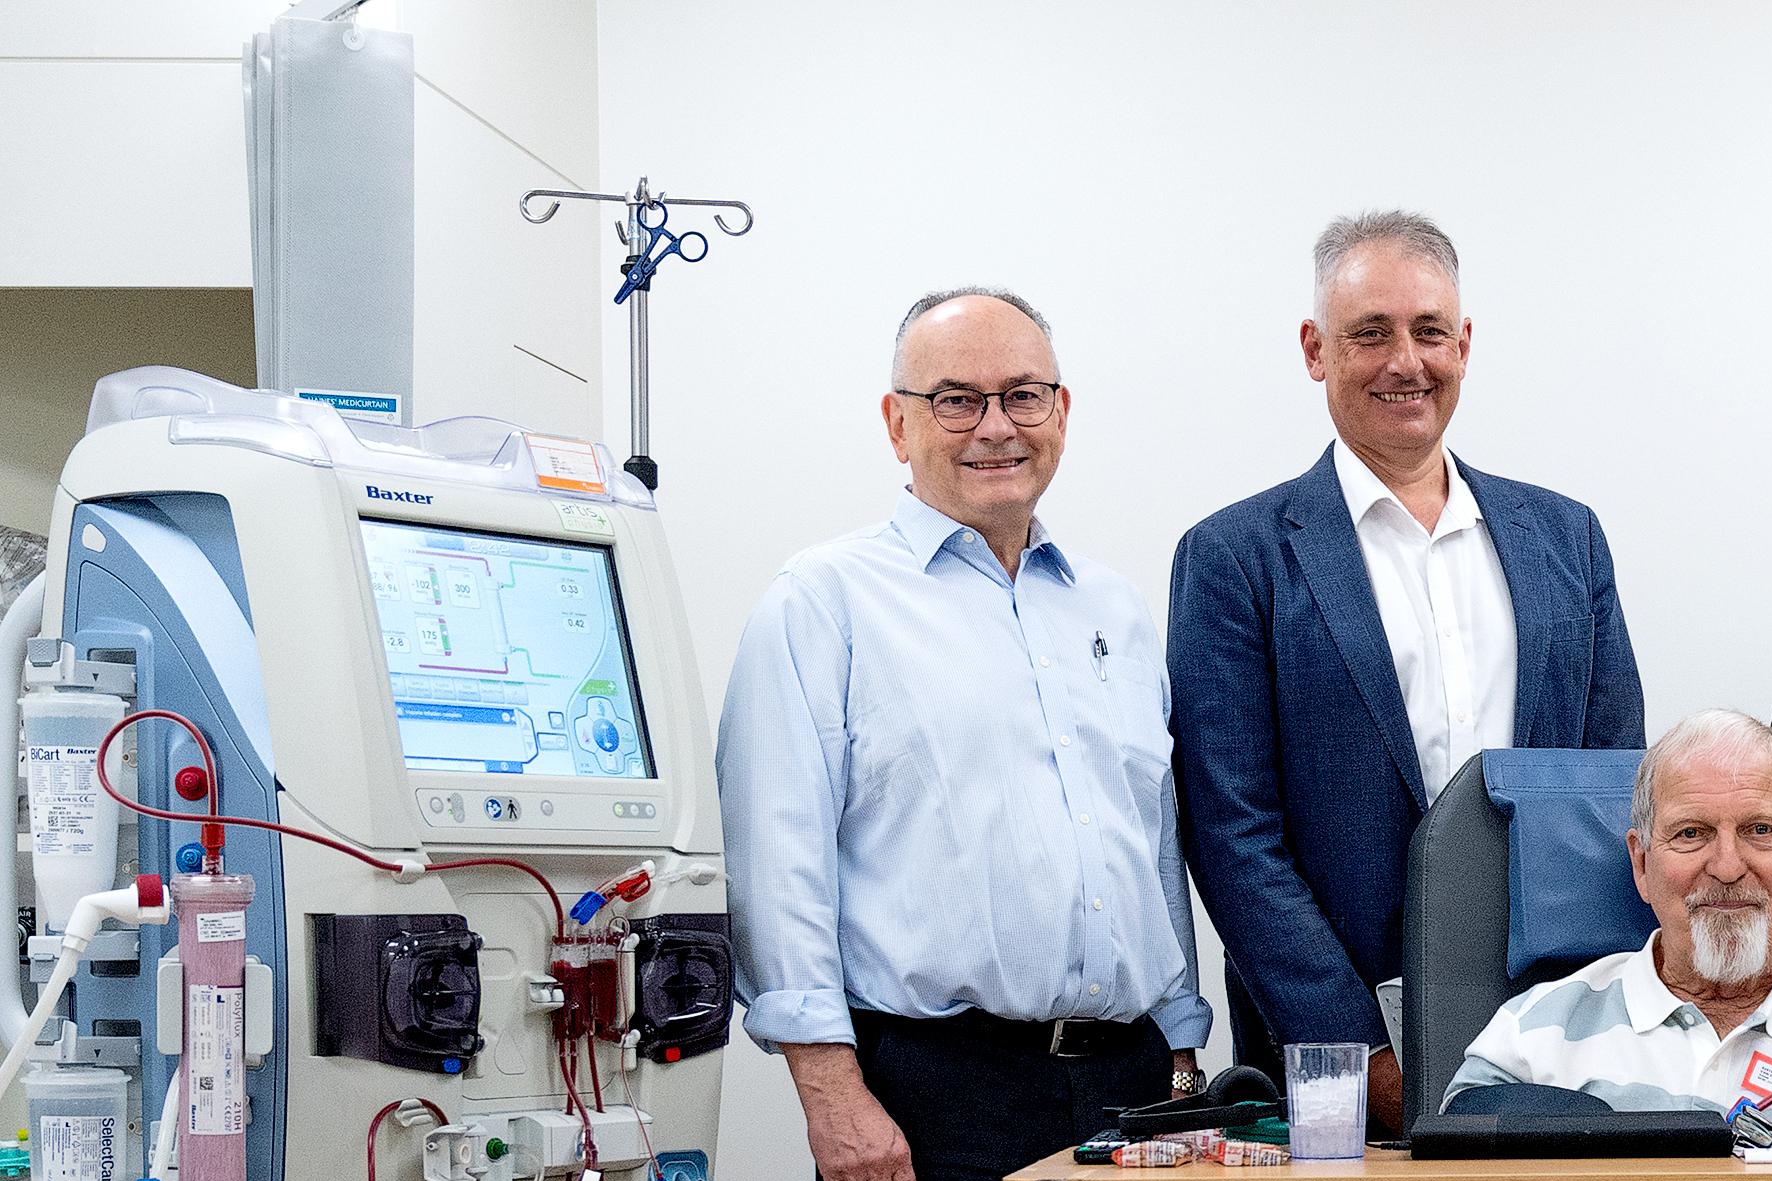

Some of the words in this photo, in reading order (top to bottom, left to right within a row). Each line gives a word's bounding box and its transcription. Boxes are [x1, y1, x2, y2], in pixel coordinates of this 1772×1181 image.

[338, 398, 389, 409] MEDICURTAIN
[366, 485, 434, 505] Baxter
[561, 503, 598, 518] artis
[469, 540, 511, 555] 2:42
[411, 579, 431, 590] -102
[454, 583, 471, 594] 300
[561, 584, 579, 594] 0.33
[568, 619, 585, 628] 0.42
[421, 630, 438, 640] 175
[30, 747, 60, 761] BiCart
[232, 992, 243, 1038] Polyflux
[233, 1101, 242, 1131] 210H
